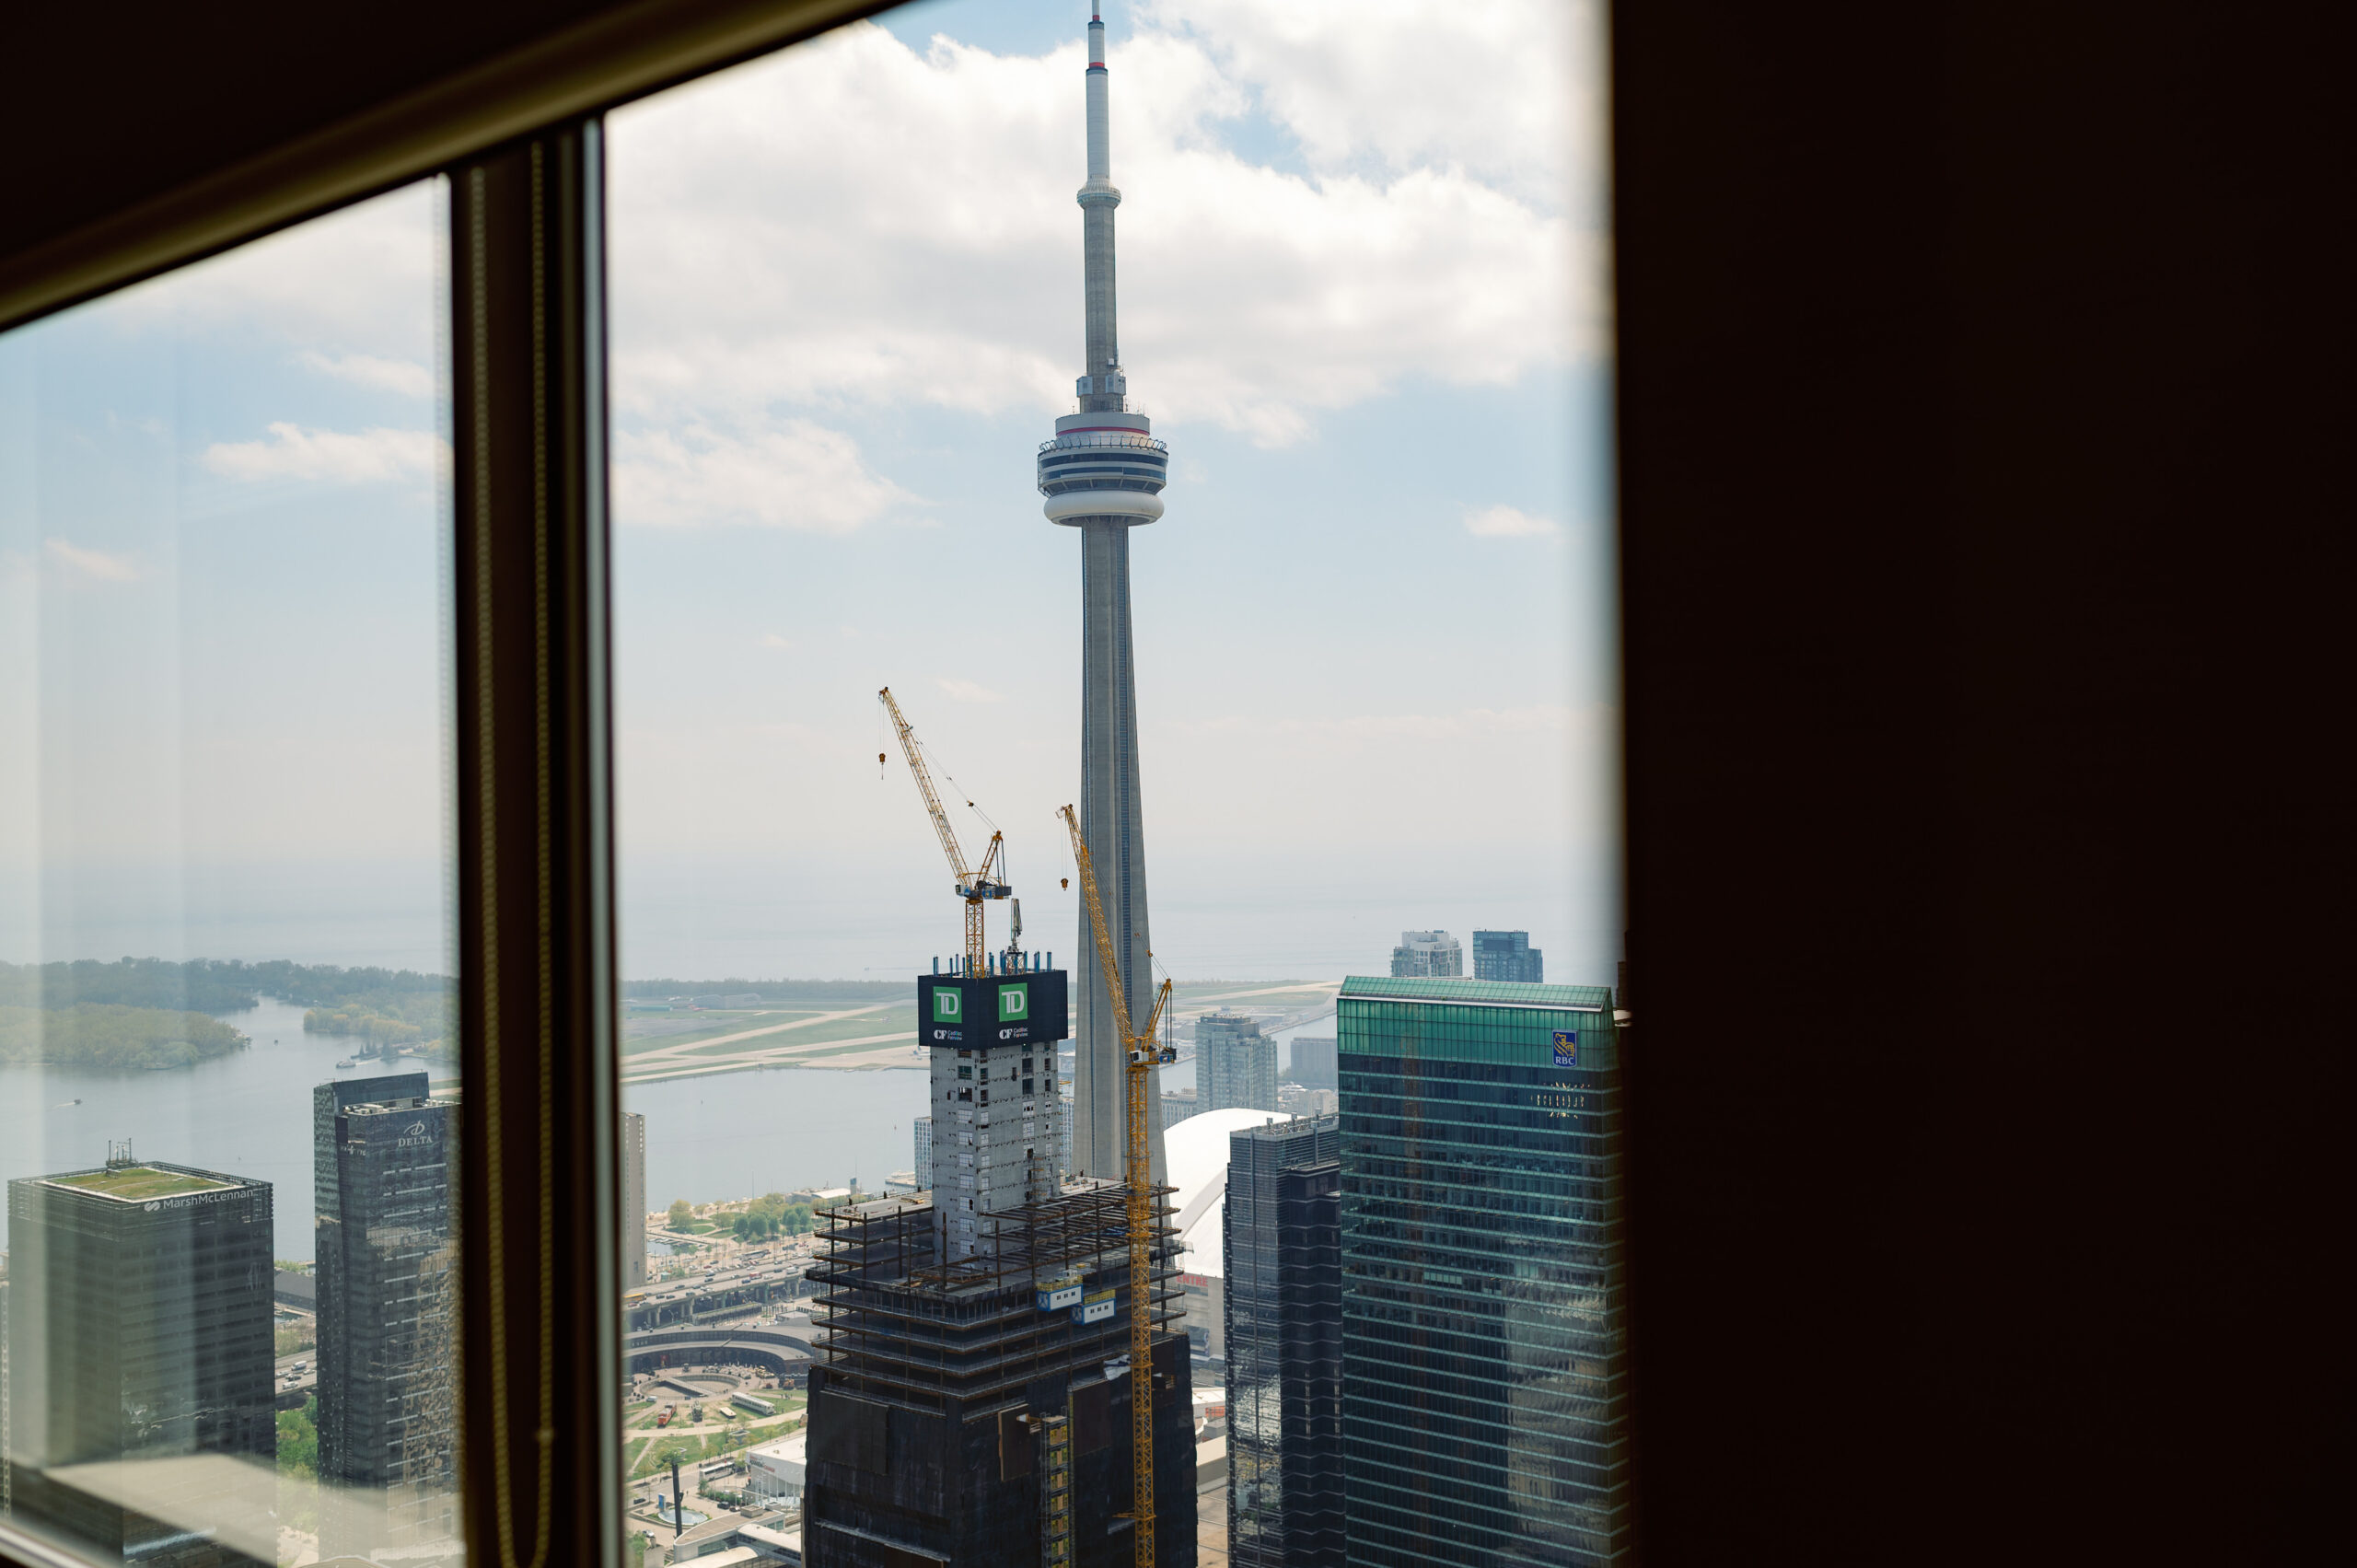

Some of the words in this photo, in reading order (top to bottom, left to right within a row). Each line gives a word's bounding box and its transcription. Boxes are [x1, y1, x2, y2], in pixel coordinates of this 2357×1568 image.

[935, 992, 958, 1015] TD
[1001, 990, 1025, 1014] TD
[934, 1029, 947, 1040] CF
[999, 1028, 1013, 1040] CF
[1555, 1056, 1573, 1064] RBC
[398, 1135, 433, 1146] DELTA
[163, 1190, 253, 1209] MarshMcLennan
